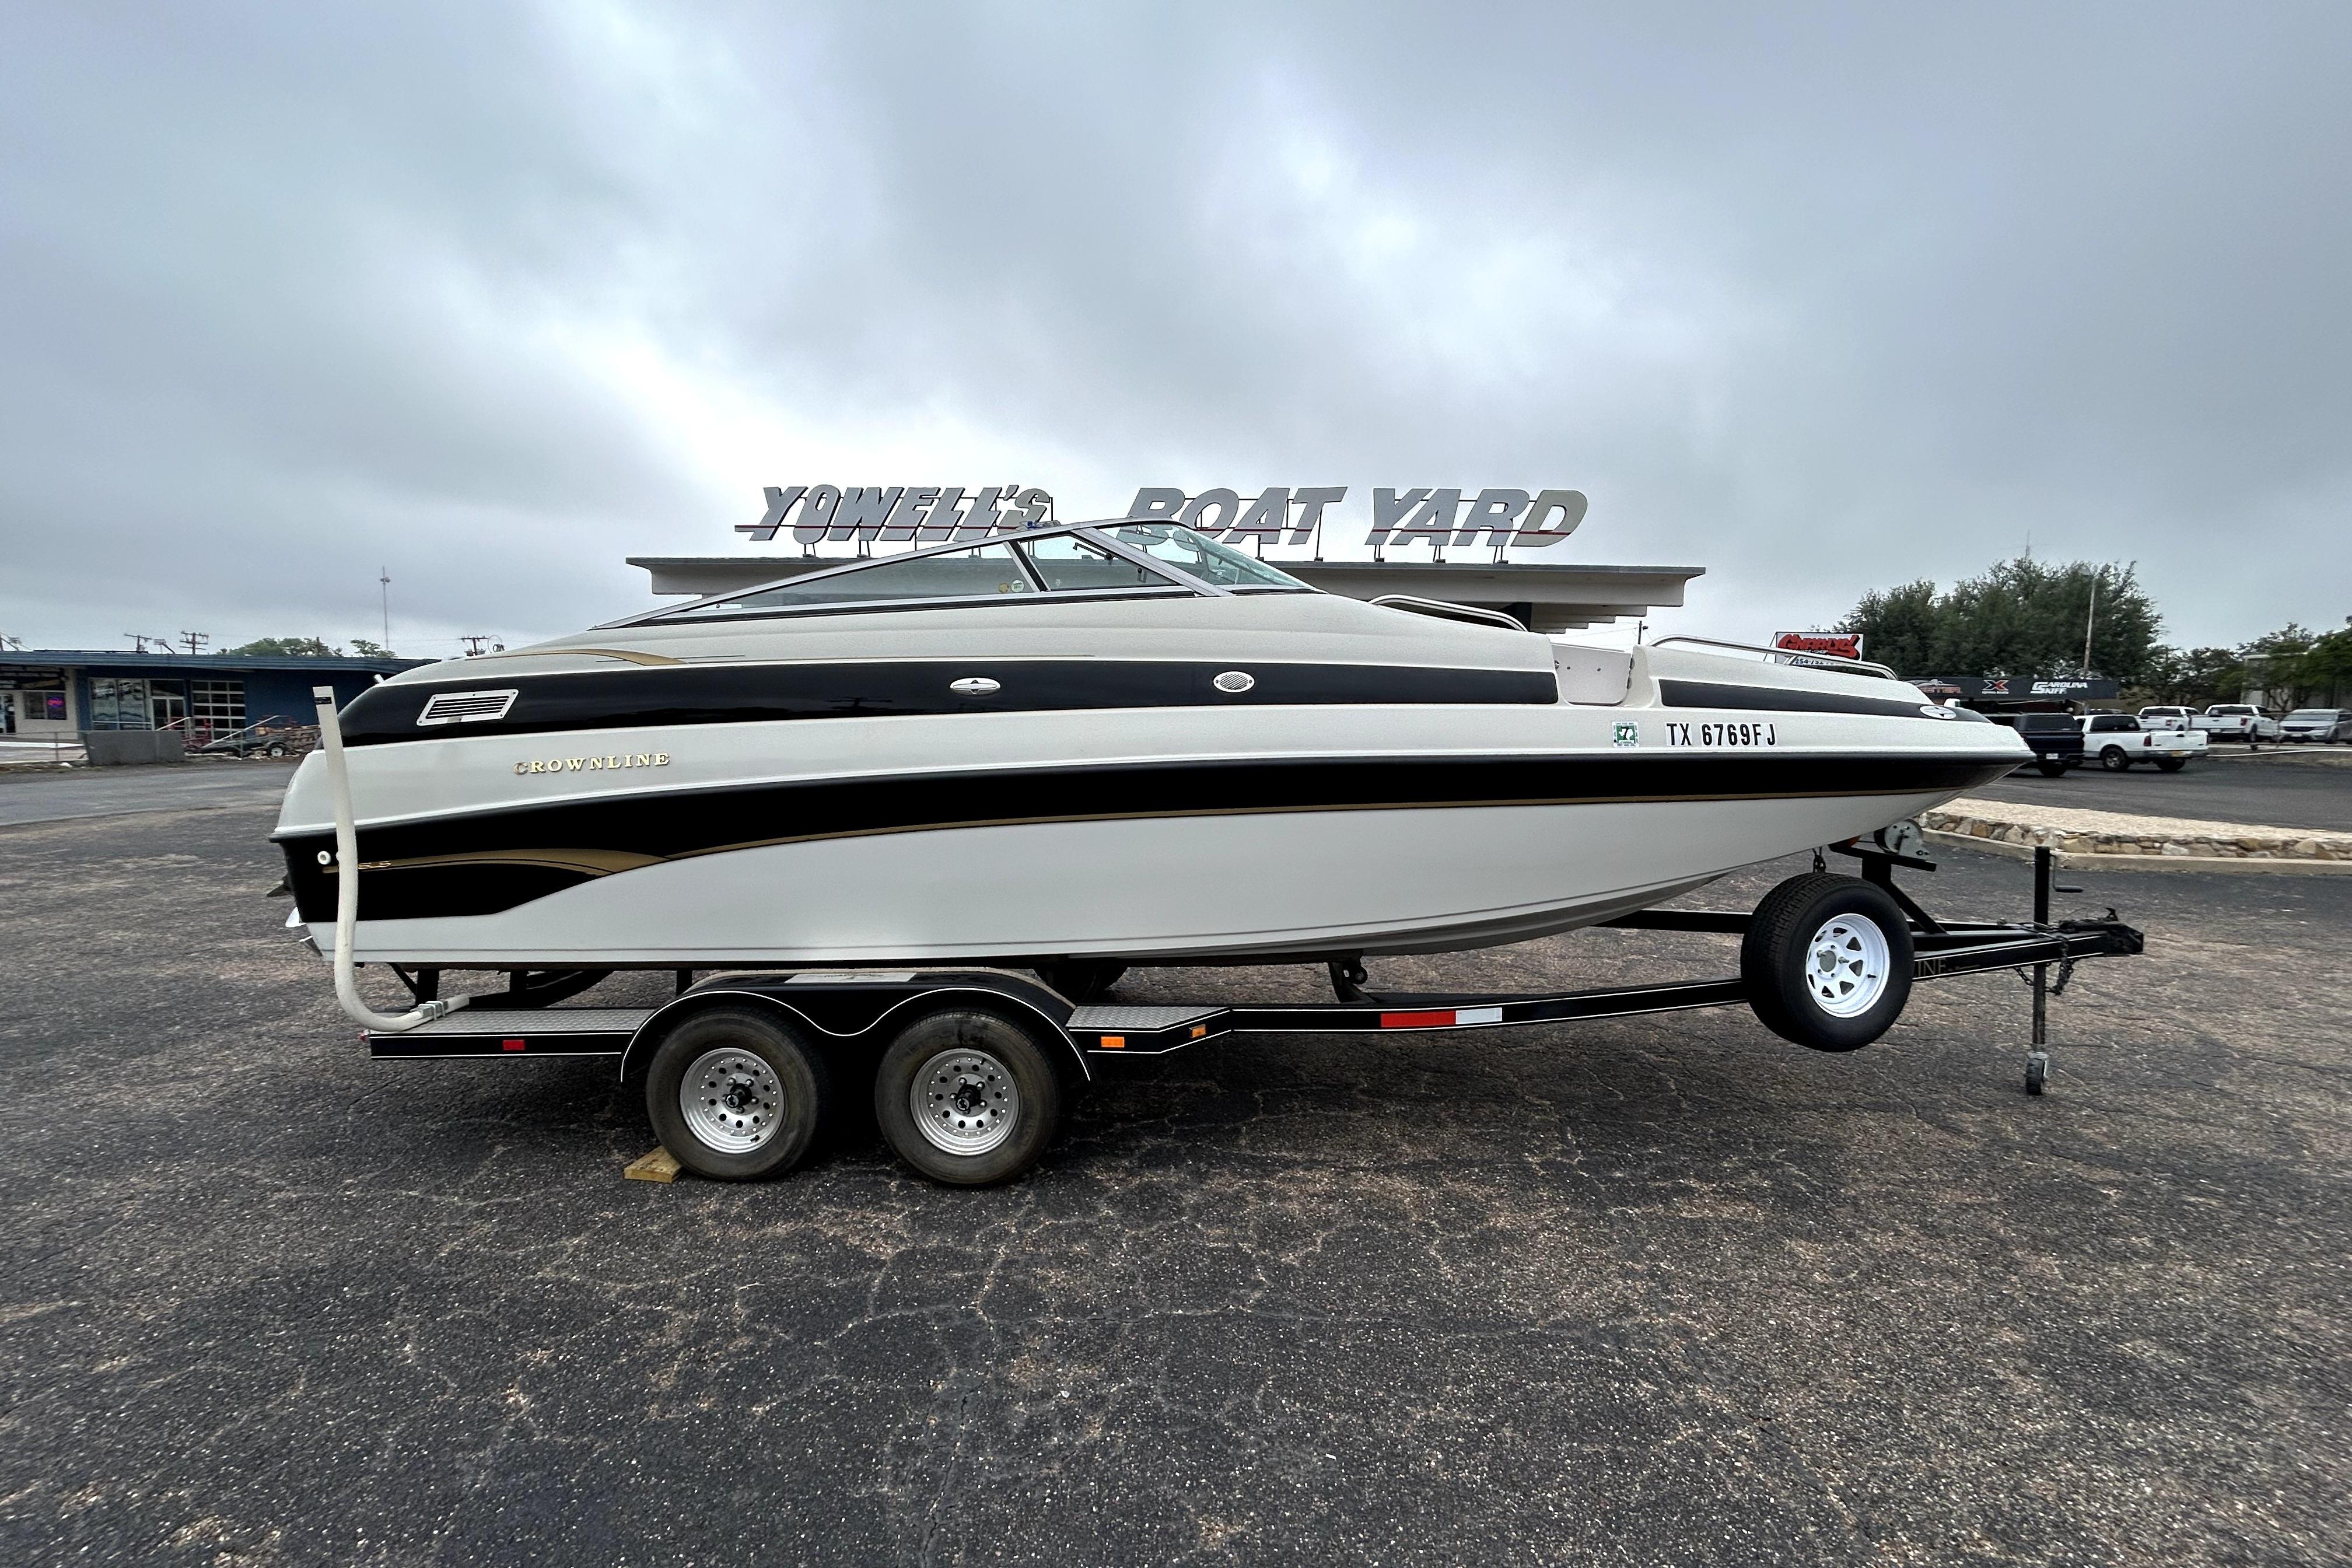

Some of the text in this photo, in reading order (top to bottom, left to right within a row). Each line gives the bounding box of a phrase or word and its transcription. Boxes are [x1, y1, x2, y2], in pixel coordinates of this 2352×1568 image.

[749, 484, 1588, 547] YOWELL'S BOAT YARD
[1666, 723, 1776, 746] TX 6769FJ
[513, 752, 669, 775] CROWNLINE
